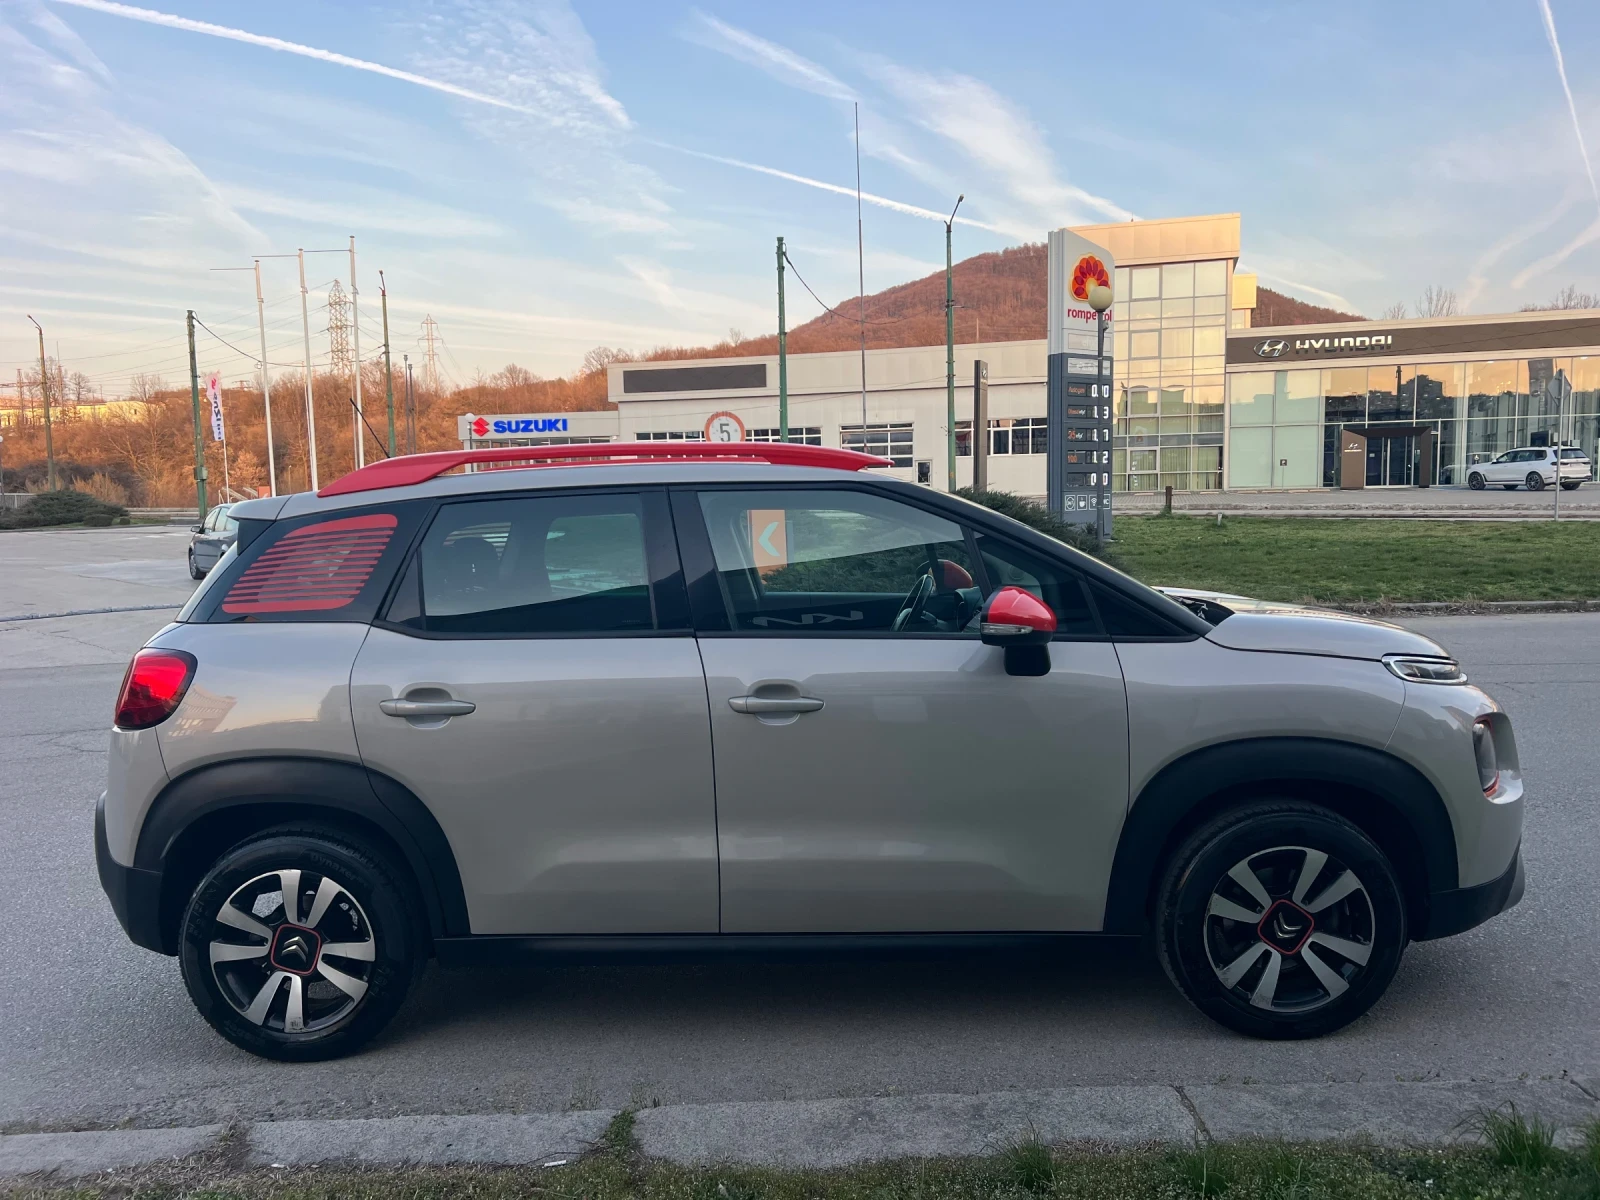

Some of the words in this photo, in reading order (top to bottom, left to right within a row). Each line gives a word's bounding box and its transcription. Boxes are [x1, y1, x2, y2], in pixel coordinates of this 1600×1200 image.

[1067, 309, 1112, 323] rompeol
[1295, 335, 1393, 355] HYUNDAI
[493, 418, 568, 434] SUZUKI
[719, 422, 731, 442] 5
